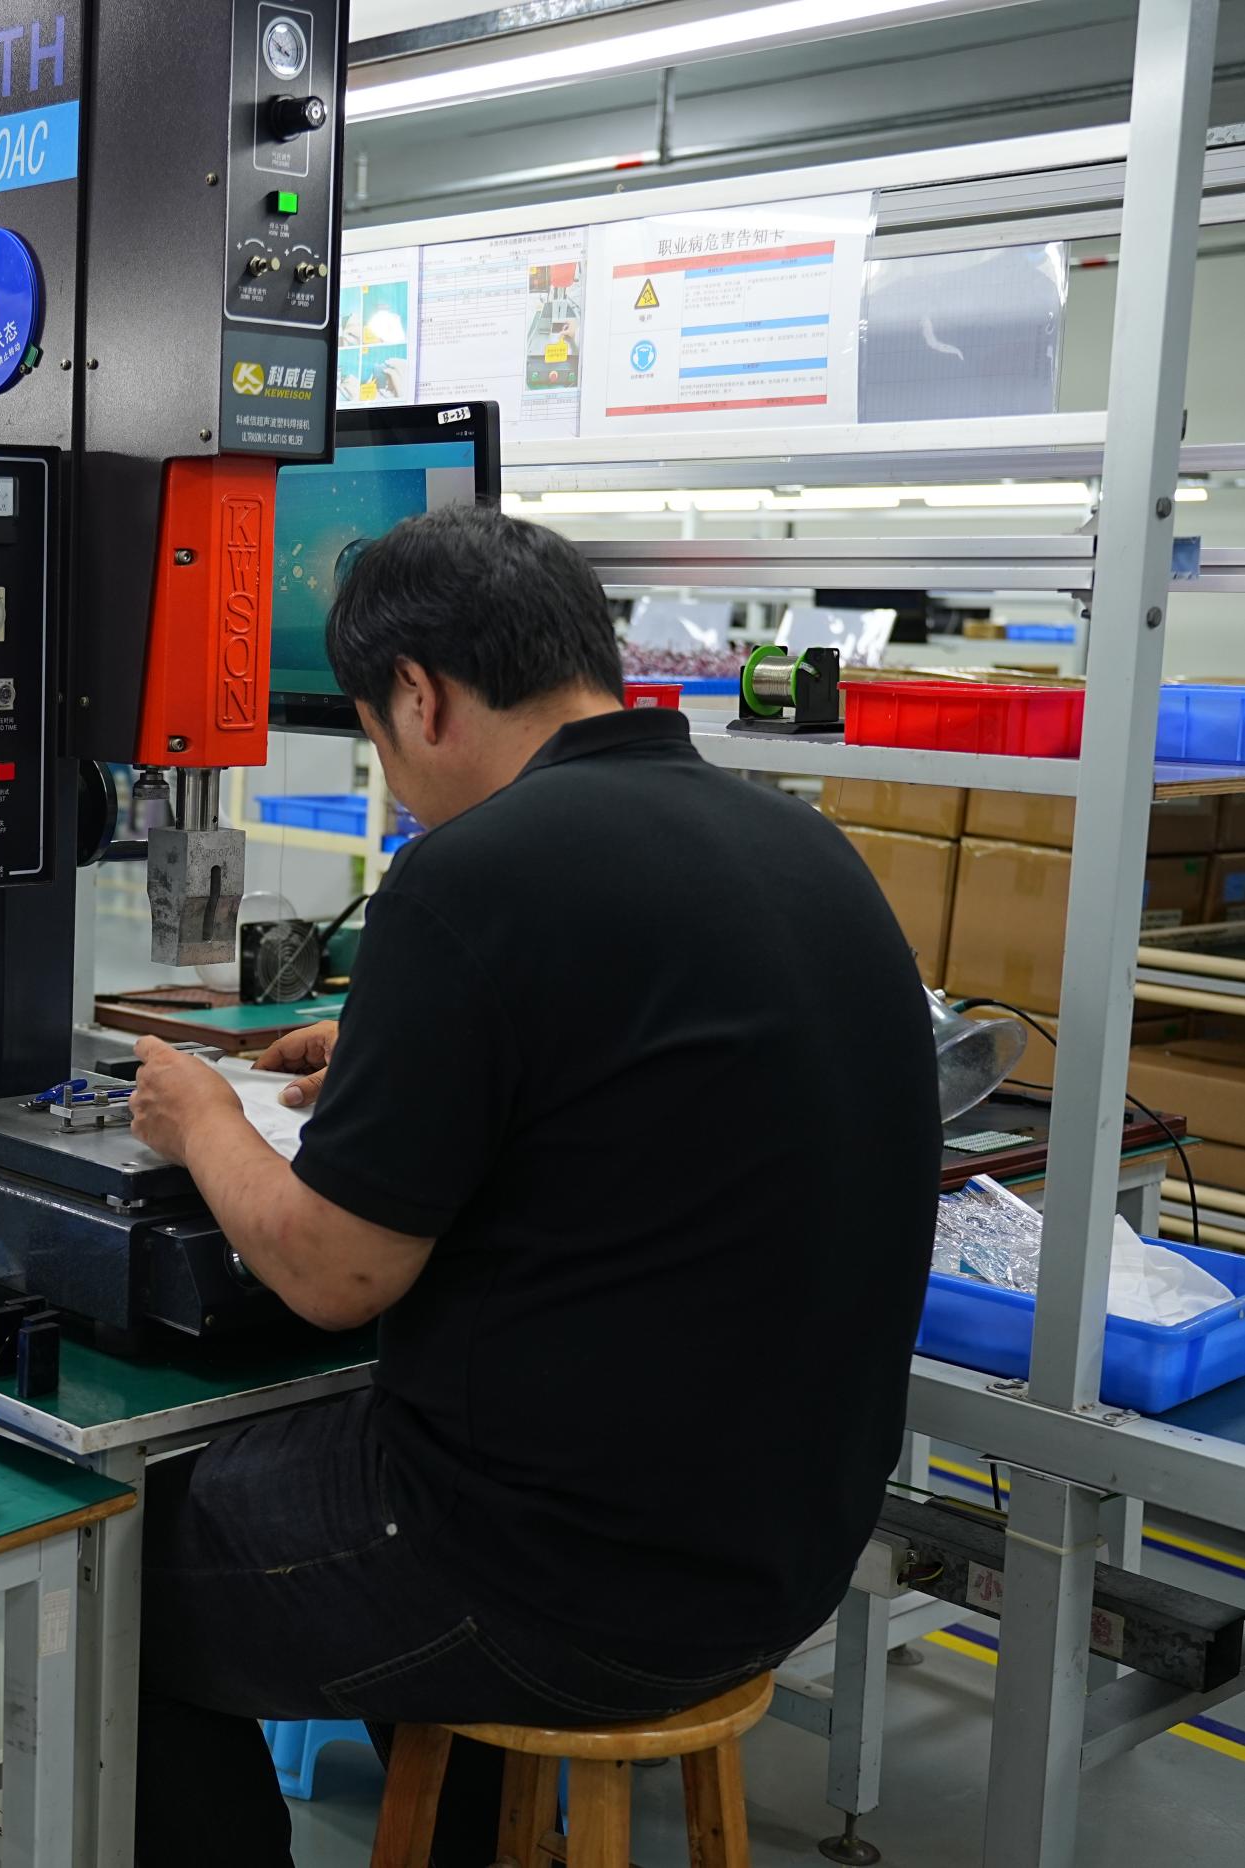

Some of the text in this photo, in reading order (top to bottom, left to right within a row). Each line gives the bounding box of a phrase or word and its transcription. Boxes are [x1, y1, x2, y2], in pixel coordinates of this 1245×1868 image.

[657, 228, 786, 257] 职业病危害告知卡
[267, 366, 317, 389] 科威信
[264, 388, 312, 400] KEWEISON
